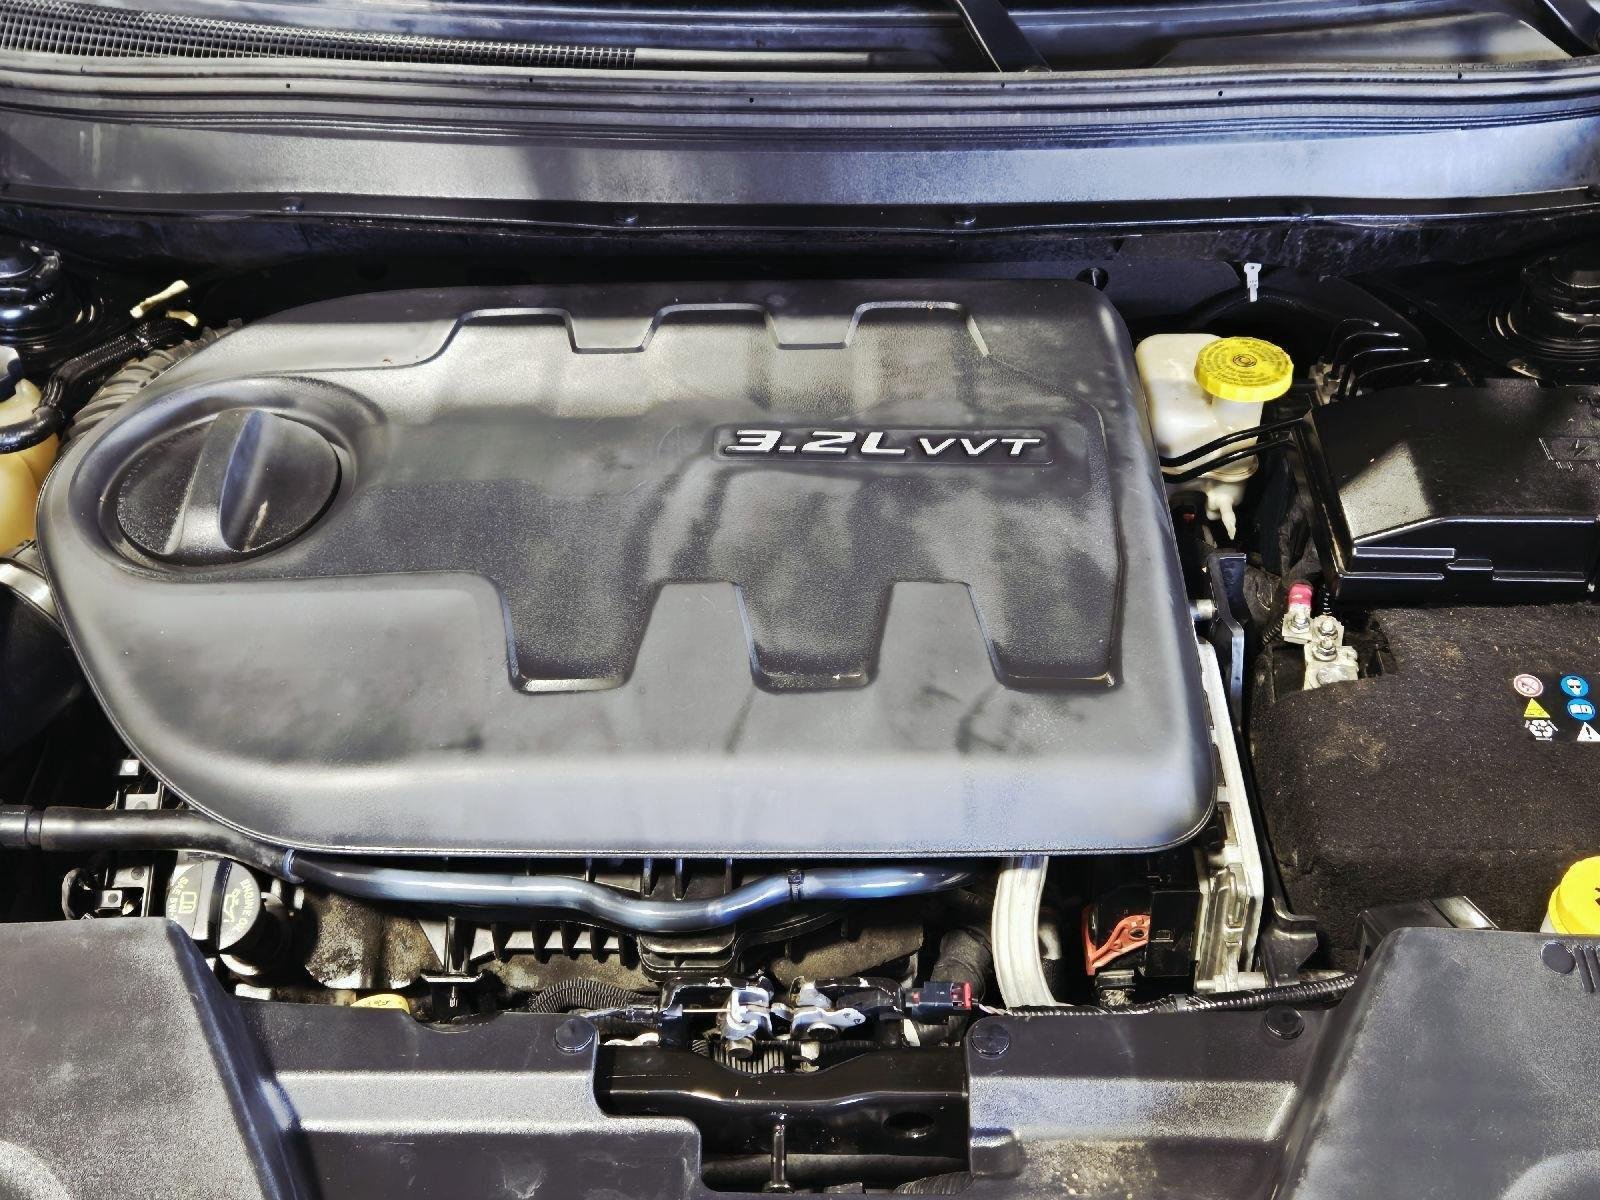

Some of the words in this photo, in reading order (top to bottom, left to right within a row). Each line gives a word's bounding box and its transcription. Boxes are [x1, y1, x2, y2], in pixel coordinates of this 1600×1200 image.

[724, 429, 906, 455] 3.2L
[918, 437, 1041, 456] VVT
[240, 879, 255, 917] ENGINE
